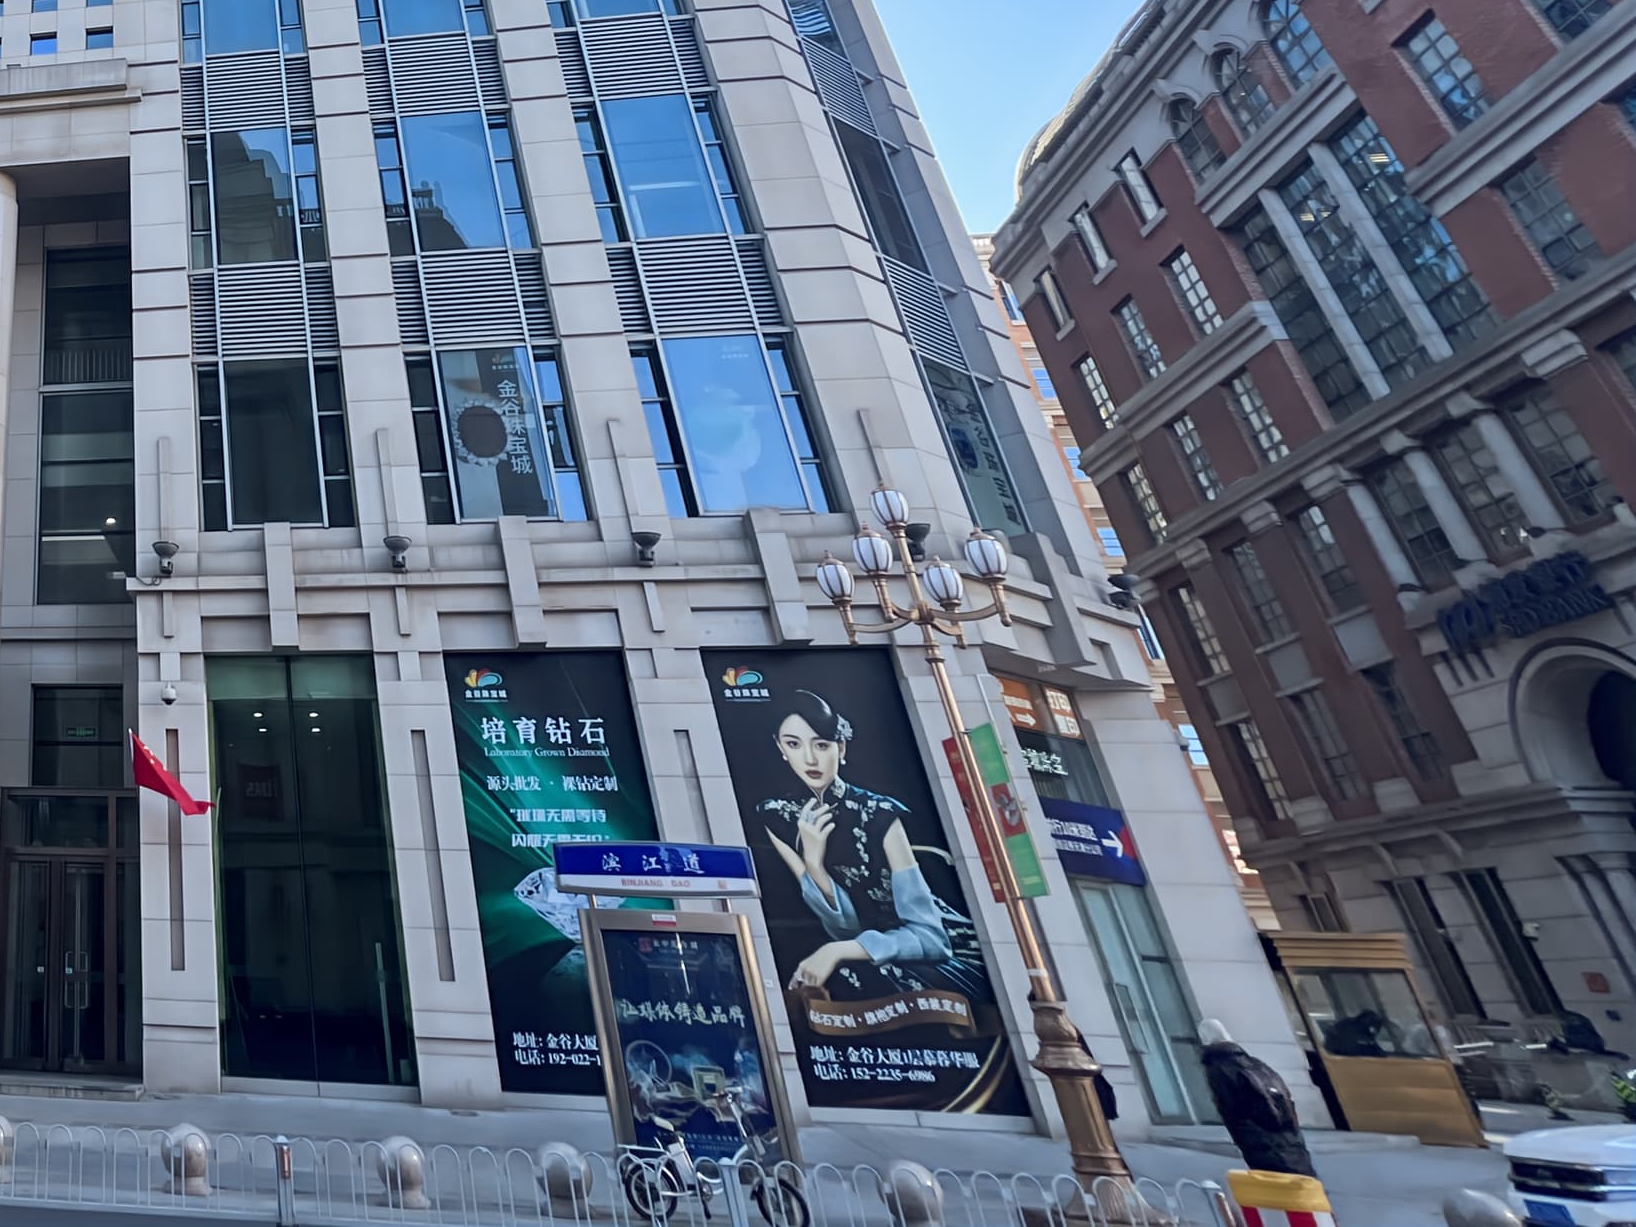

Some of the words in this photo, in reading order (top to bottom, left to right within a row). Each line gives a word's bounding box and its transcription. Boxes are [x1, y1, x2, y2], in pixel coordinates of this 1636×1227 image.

[497, 379, 533, 474] 金谷珠宝城
[481, 717, 606, 745] 培育钻石
[484, 747, 533, 758] Laboratory
[534, 747, 565, 757] Grown
[567, 747, 610, 757] Diamond
[486, 775, 542, 792] 源头批发
[602, 853, 706, 874] 滨江道
[621, 878, 663, 887] BINJIANG
[671, 879, 691, 888] DAO
